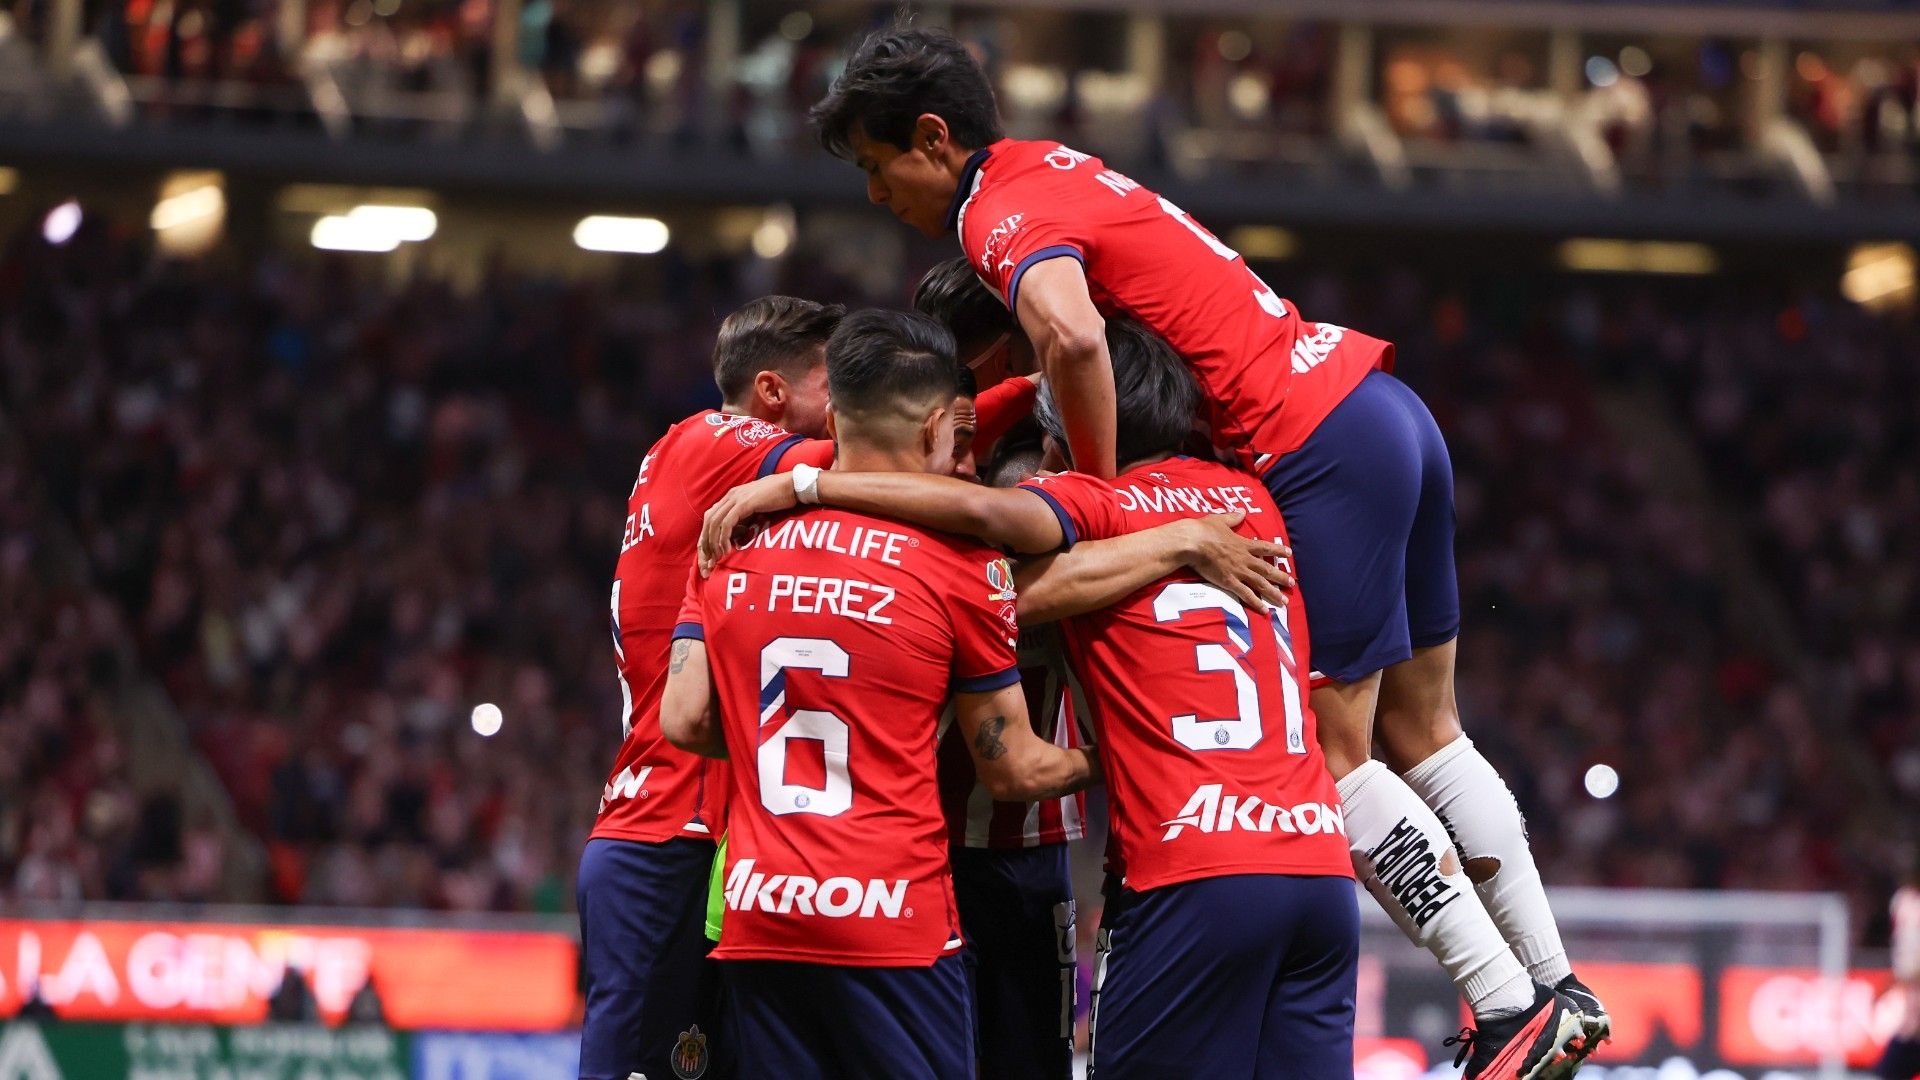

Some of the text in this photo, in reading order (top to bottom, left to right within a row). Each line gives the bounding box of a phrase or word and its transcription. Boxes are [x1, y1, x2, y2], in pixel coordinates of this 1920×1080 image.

[768, 574, 896, 625] PEREZ
[1153, 583, 1305, 754] 31
[757, 637, 853, 817] 6
[1160, 783, 1345, 842] AKRON
[724, 858, 910, 918] AKRON
[1368, 816, 1461, 929] PERDURA
